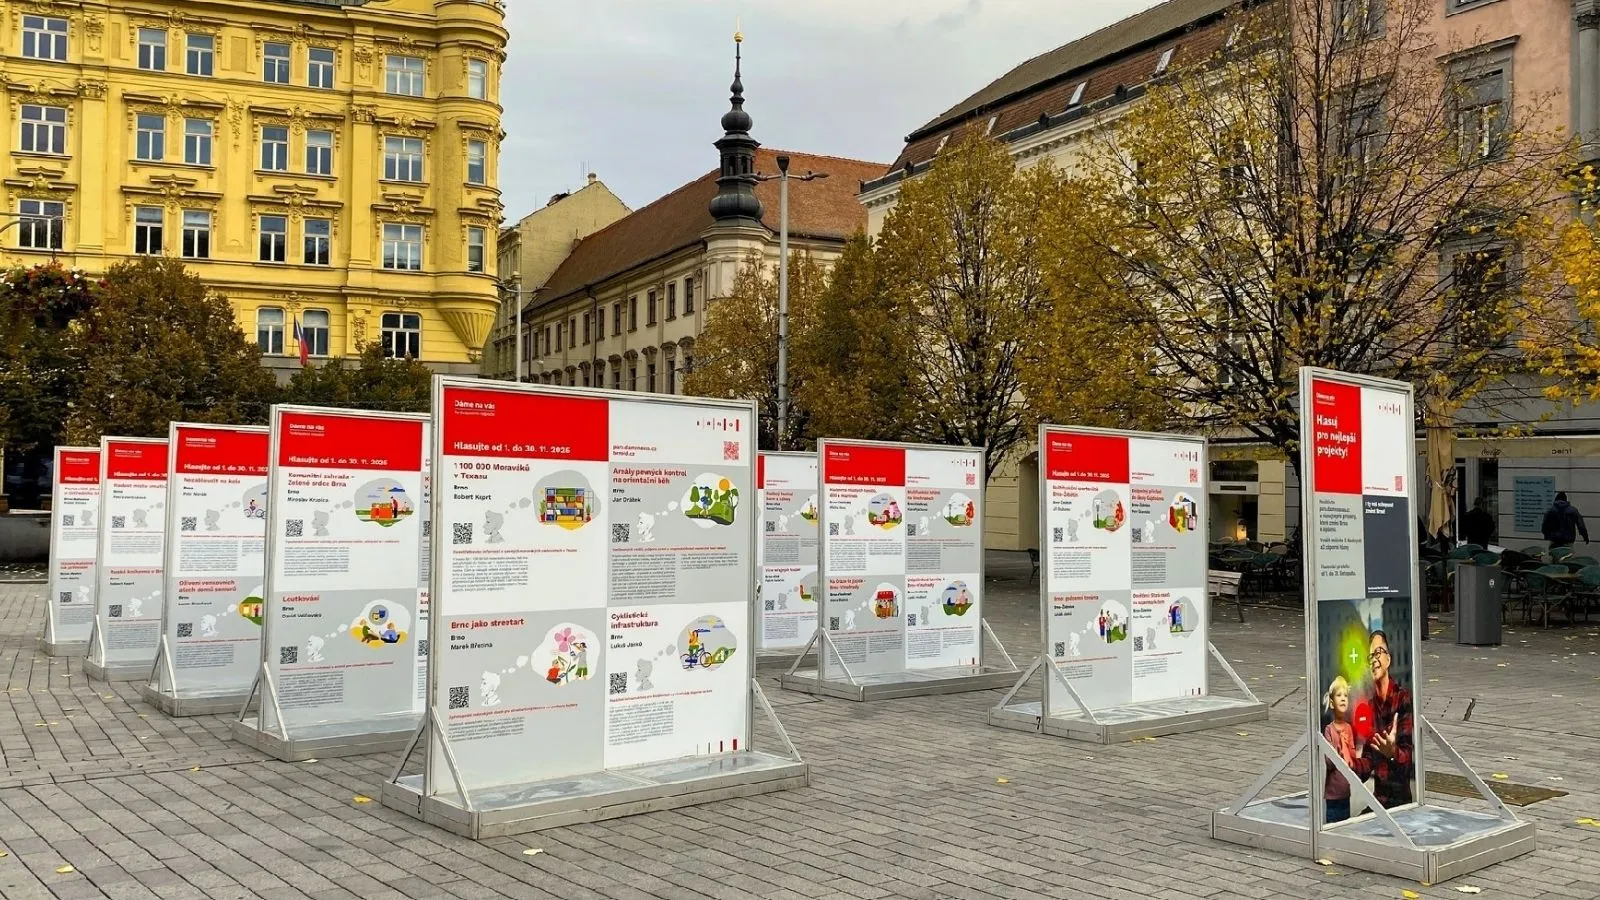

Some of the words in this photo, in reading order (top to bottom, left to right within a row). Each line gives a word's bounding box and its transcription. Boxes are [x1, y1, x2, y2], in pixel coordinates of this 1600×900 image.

[455, 400, 474, 408] Dáme
[485, 402, 495, 410] vás
[1317, 415, 1338, 428] Hlasuj
[1317, 431, 1328, 442] pro
[1330, 432, 1356, 445] nejlepší
[454, 442, 489, 452] Hlasujte
[492, 443, 502, 451] od
[512, 444, 522, 452] do
[551, 446, 571, 454] 2025
[1318, 445, 1348, 459] projekty!
[289, 456, 319, 464] Hlasujte
[461, 472, 488, 480] Texasu
[664, 468, 687, 476] kontrol
[623, 476, 657, 484] orientační
[282, 594, 320, 603] Loutkování
[451, 621, 469, 629] Brno
[471, 620, 489, 630] jako
[611, 621, 658, 629] infrastruktura
